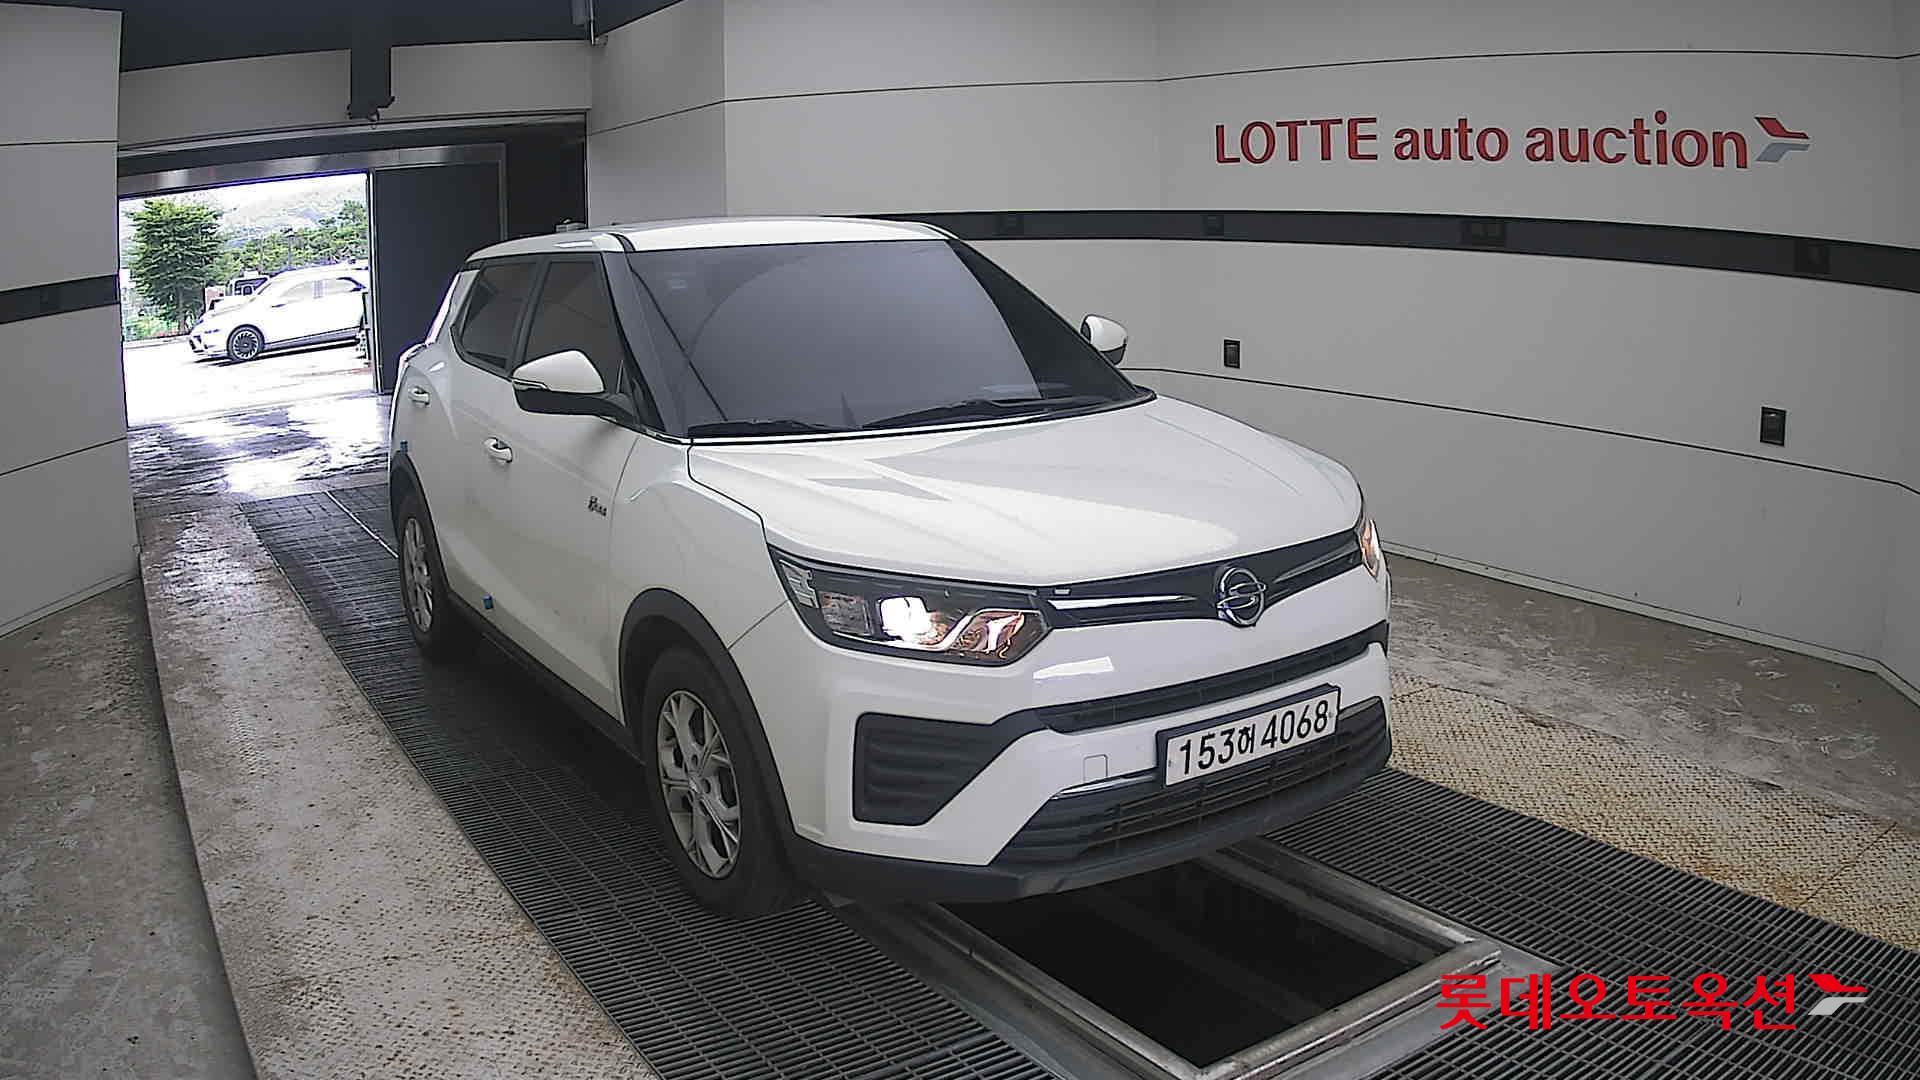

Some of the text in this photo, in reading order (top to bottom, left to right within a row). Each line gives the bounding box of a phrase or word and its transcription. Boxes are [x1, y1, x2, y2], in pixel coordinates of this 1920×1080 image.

[1215, 110, 1749, 168] LOTTE auto auction
